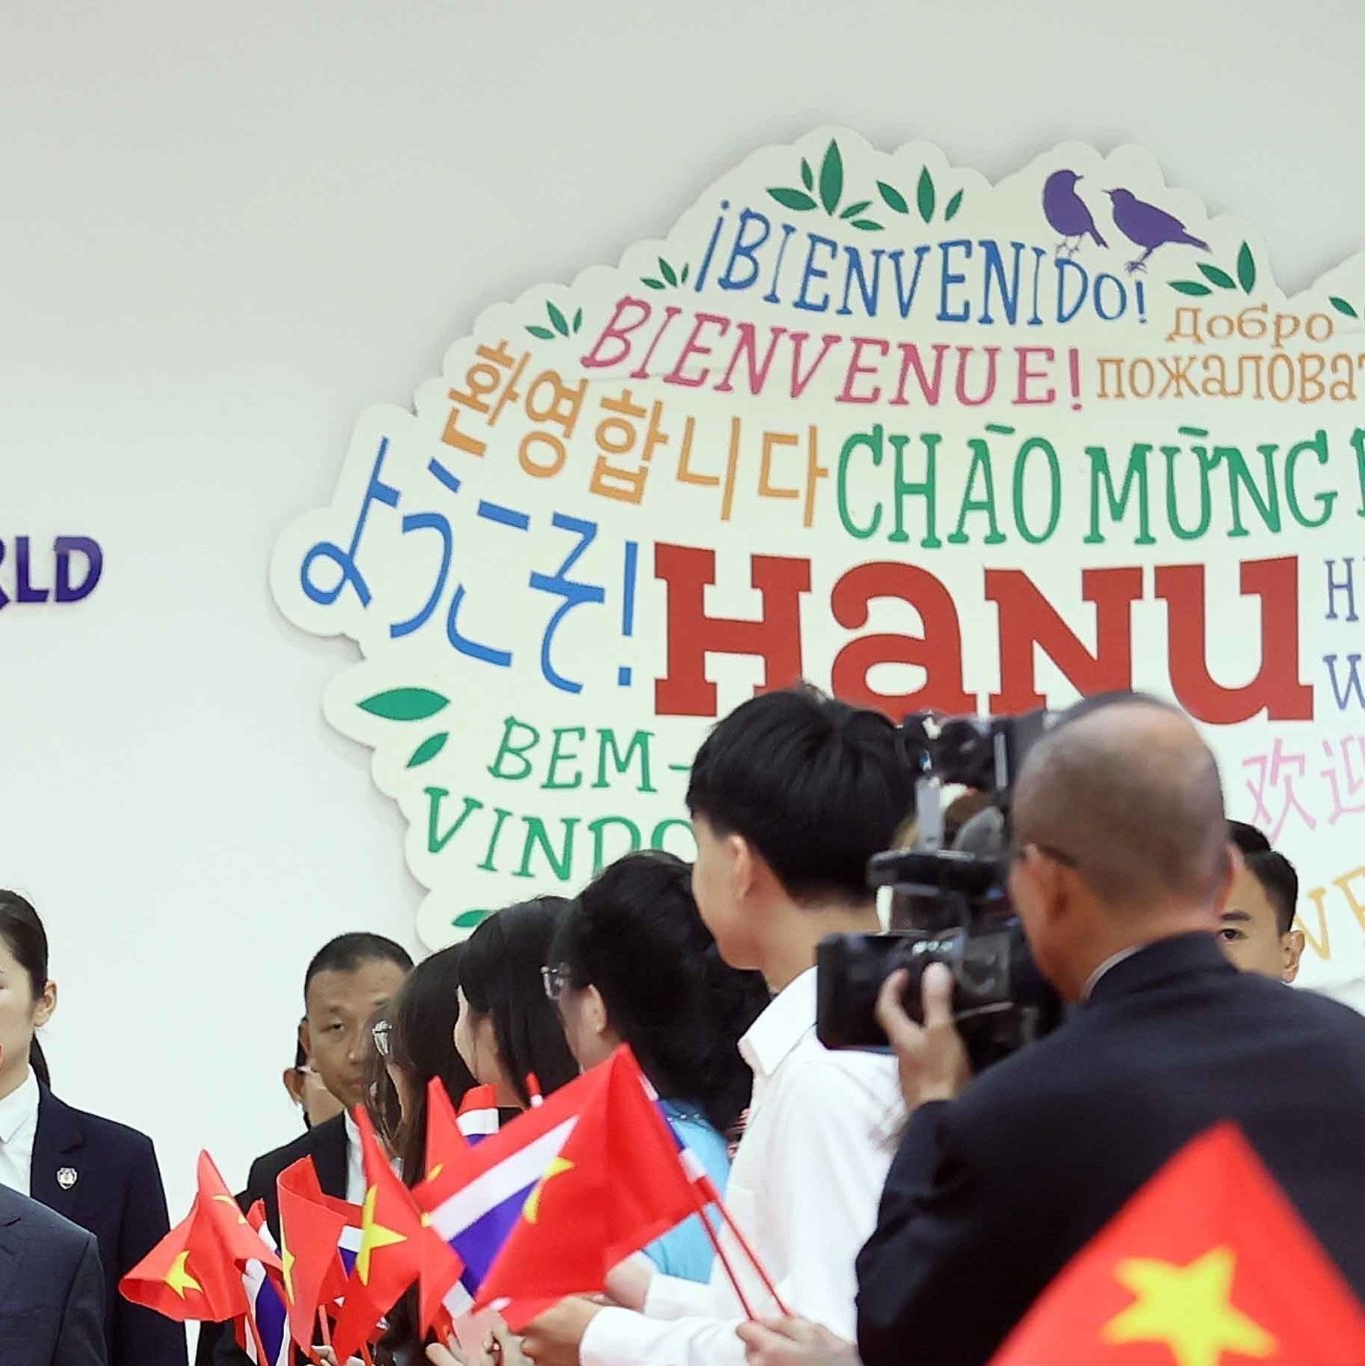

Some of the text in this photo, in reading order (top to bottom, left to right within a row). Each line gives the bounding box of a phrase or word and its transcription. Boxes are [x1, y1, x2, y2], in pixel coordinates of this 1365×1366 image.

[580, 296, 1084, 410] BIENVENUE!
[1165, 303, 1335, 348] Добро
[441, 341, 829, 527] 환영합니다
[300, 436, 639, 694] ようこそ!
[486, 715, 691, 792] BEM-
